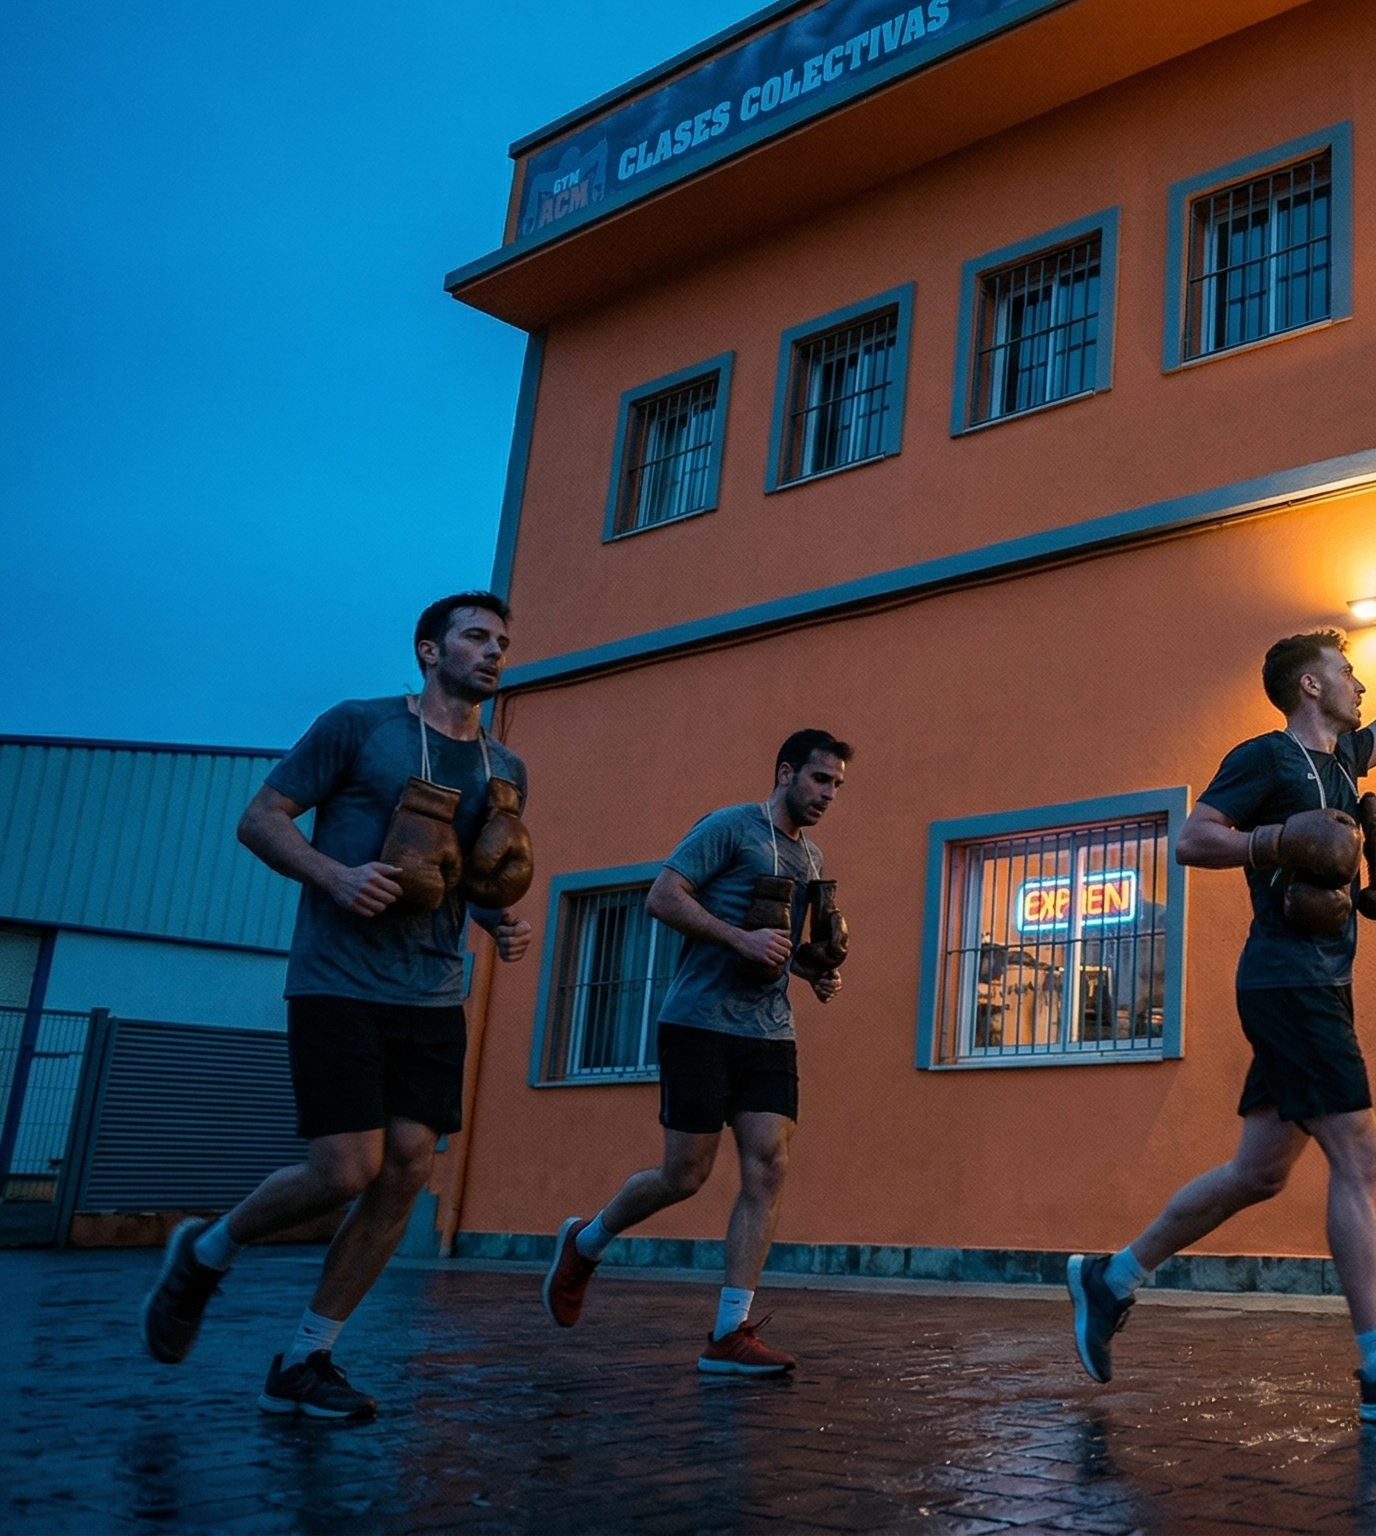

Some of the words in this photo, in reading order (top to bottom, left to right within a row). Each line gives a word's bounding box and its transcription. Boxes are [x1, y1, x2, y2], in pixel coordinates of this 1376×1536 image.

[618, 101, 731, 181] CLASES
[739, 0, 950, 121] COLECTIVAS
[538, 179, 590, 230] ACM
